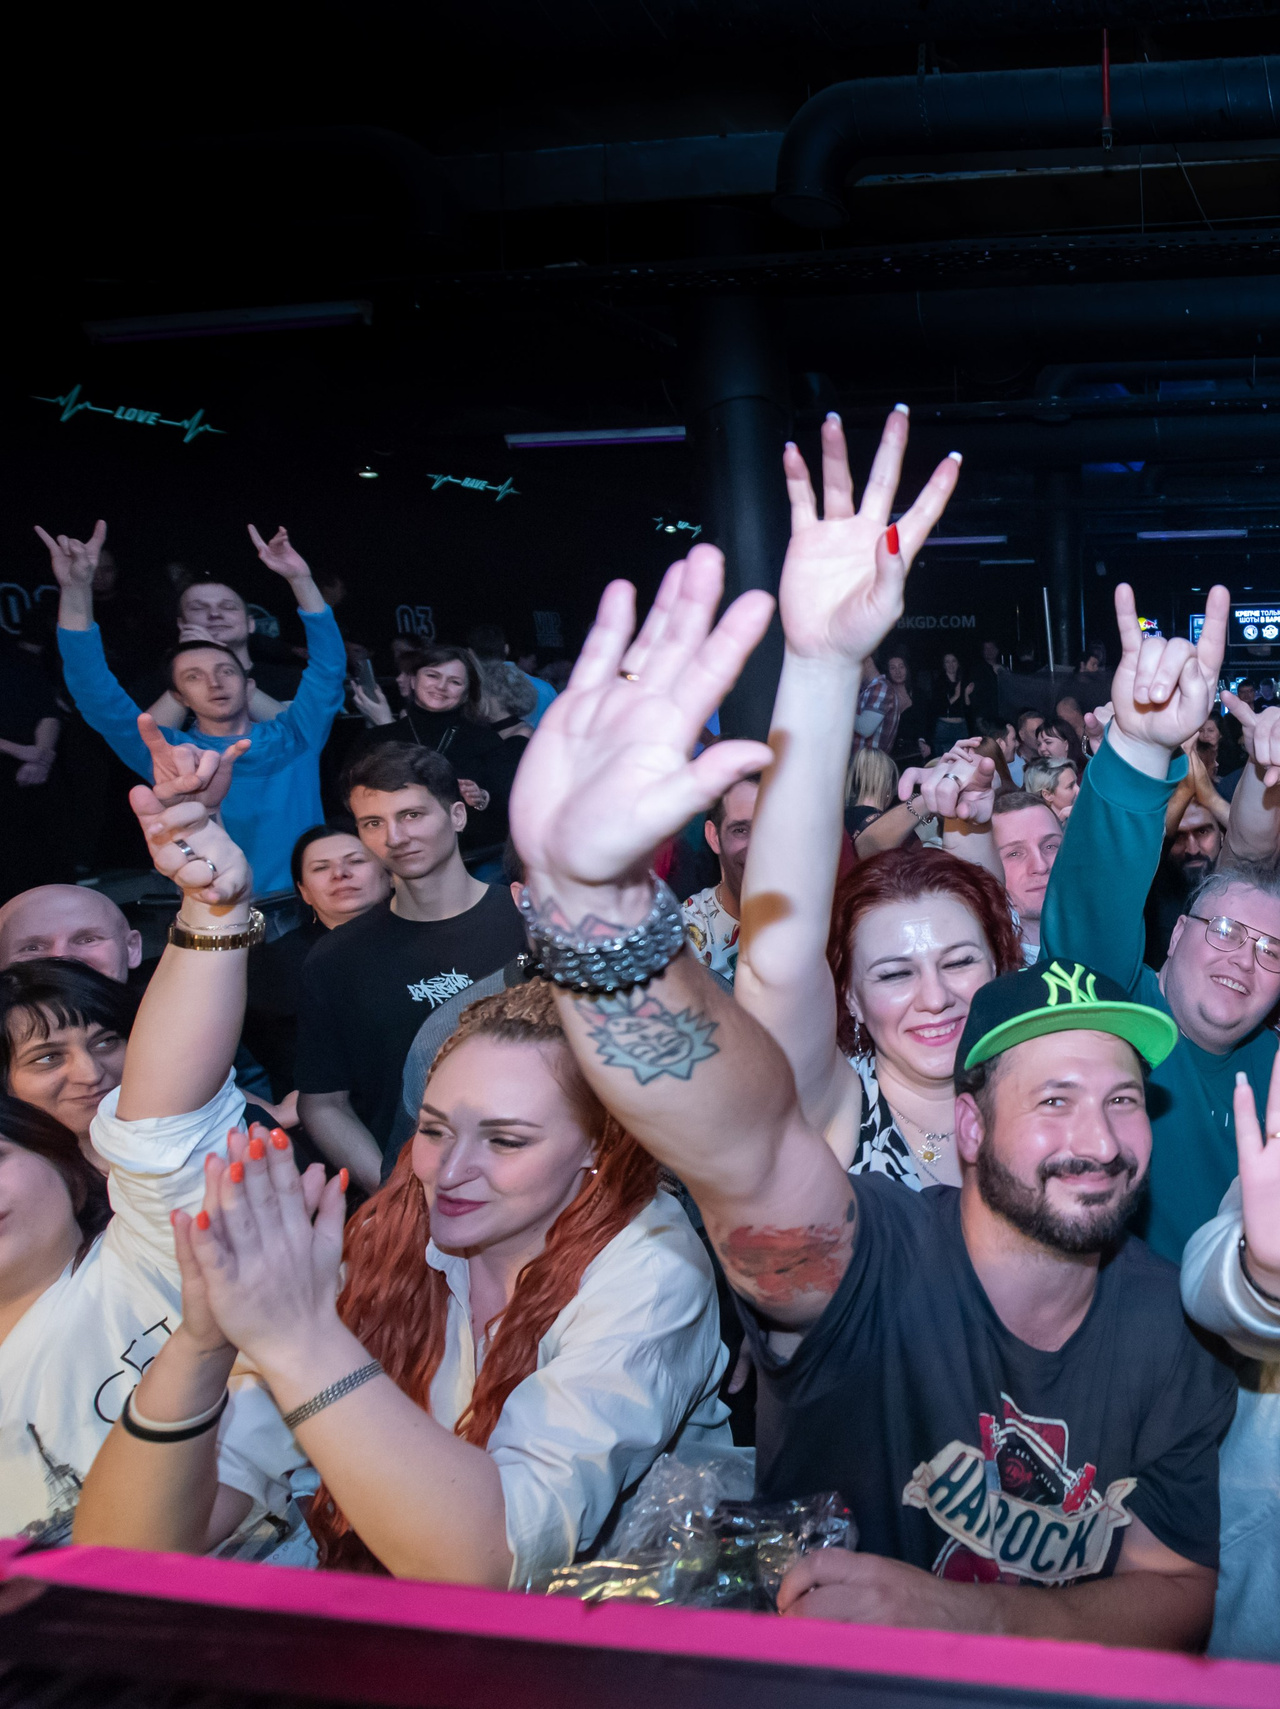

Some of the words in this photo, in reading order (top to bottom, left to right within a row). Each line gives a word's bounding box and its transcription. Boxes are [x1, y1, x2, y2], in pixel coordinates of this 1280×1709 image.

[114, 405, 161, 426] LOVE
[0, 582, 59, 635] 0
[395, 604, 436, 642] 03
[897, 614, 976, 629] BKGD.COM
[1041, 961, 1098, 1006] NY
